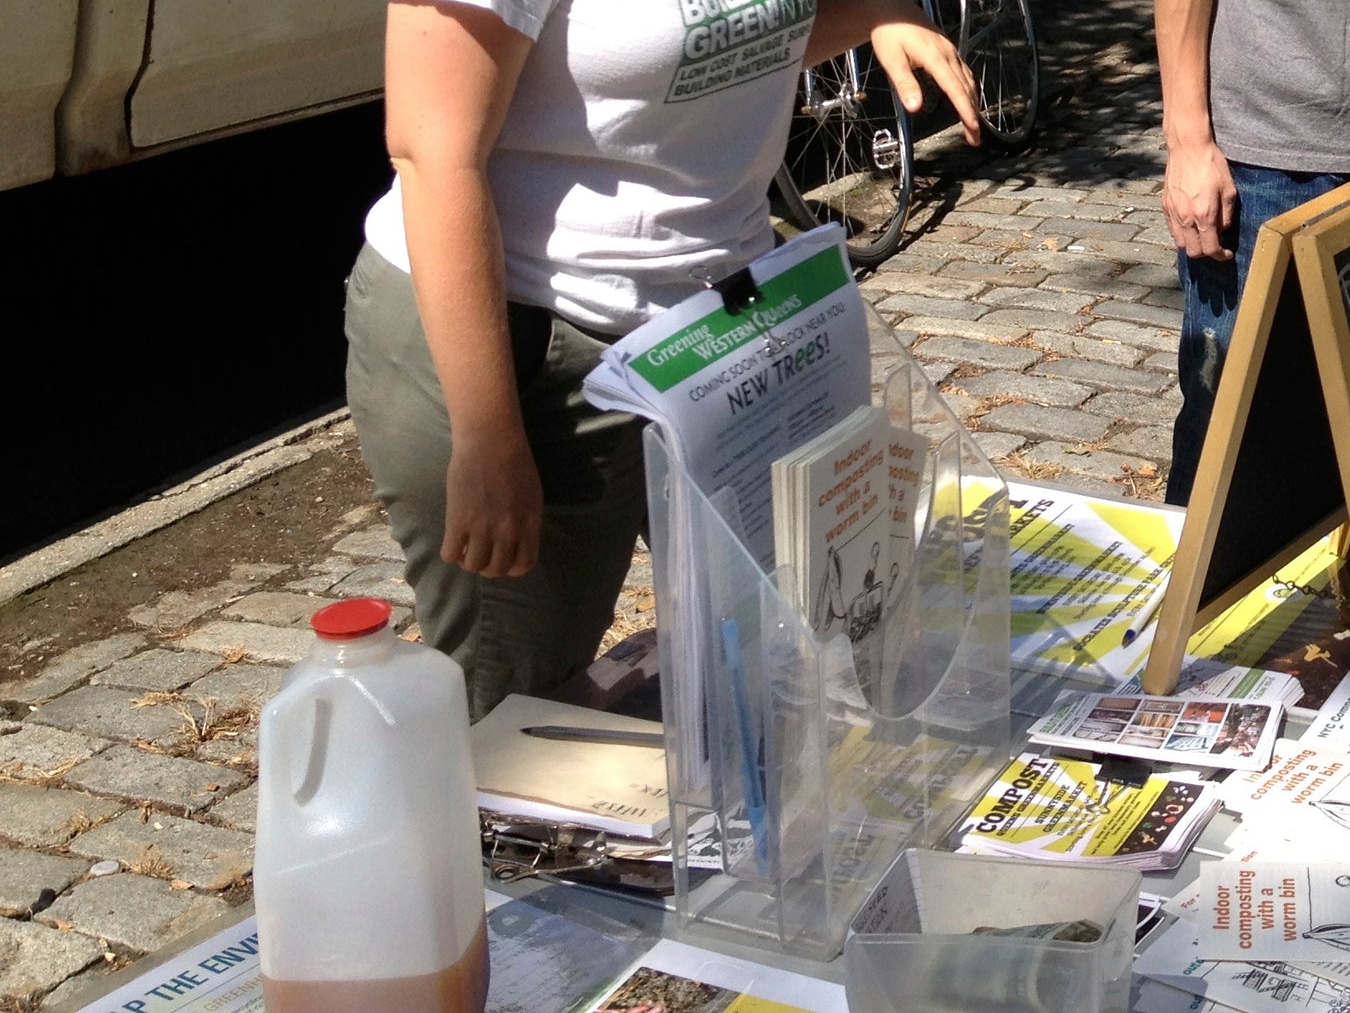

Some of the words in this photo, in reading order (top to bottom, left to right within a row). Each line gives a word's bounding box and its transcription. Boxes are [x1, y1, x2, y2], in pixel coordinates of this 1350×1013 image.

[673, 69, 733, 97] BUILDING
[734, 47, 791, 79] MATERIALS
[709, 53, 738, 72] COST
[646, 323, 716, 368] Greening
[689, 369, 730, 402] COMING
[730, 356, 757, 381] SOON
[726, 367, 769, 417] NEW
[818, 449, 884, 508] composting
[834, 439, 872, 476] Indoor
[825, 510, 860, 543] worm
[862, 493, 878, 516] bin
[835, 488, 860, 516] with
[863, 480, 871, 494] a
[1317, 723, 1337, 739] NYC
[1250, 748, 1318, 801] composting
[1281, 772, 1307, 792] with
[1306, 763, 1319, 772] a
[1291, 777, 1326, 804] worm
[1322, 761, 1344, 779] bin
[975, 757, 1050, 835] COMPOST
[1035, 783, 1070, 825] SUNNYSIDE
[1043, 780, 1087, 833] GREENMARKET
[1180, 897, 1196, 909] For
[1212, 885, 1231, 930] Indoor
[1262, 887, 1274, 896] a
[1278, 878, 1296, 898] bin
[1234, 870, 1256, 950] composting
[1257, 898, 1275, 930] with
[1283, 902, 1298, 942] worm
[143, 969, 210, 1003] THE
